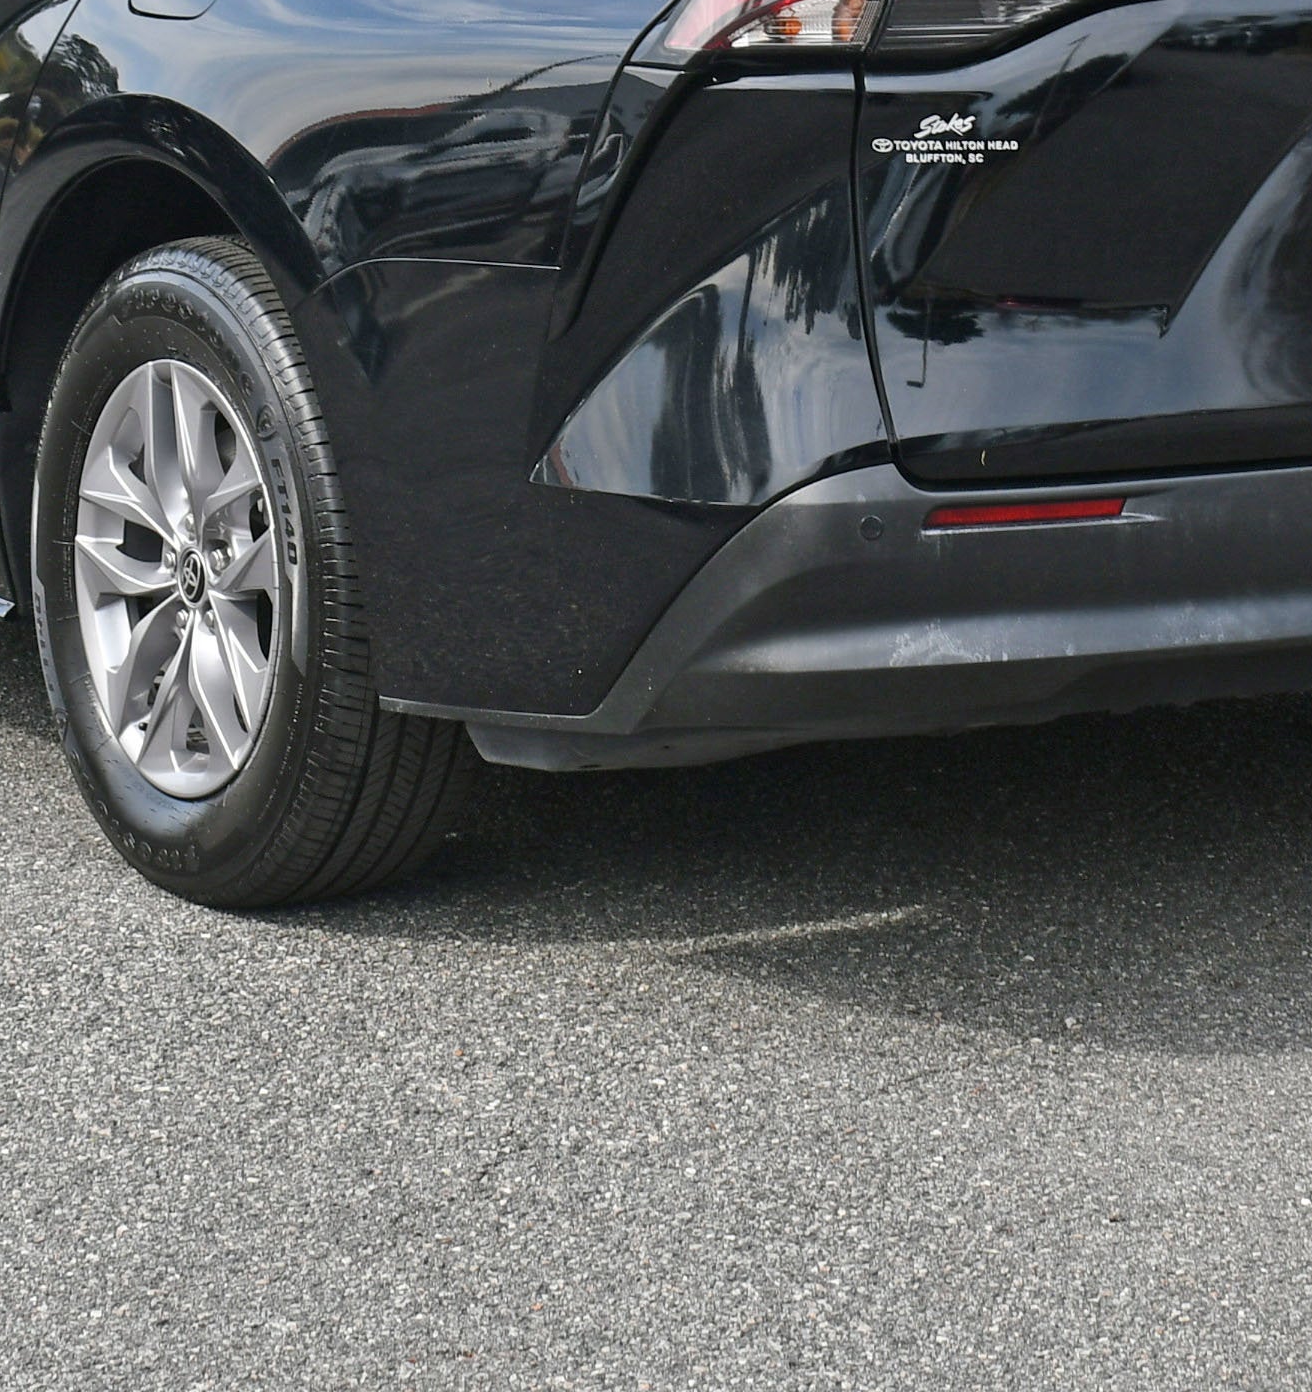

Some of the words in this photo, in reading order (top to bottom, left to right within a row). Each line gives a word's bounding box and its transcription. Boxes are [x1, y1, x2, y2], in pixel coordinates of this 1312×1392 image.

[914, 113, 976, 138] Stokes
[893, 140, 944, 151] TOYOTA
[945, 140, 985, 151] HILTON
[987, 140, 1019, 151] HEAD
[905, 153, 966, 165] BLUFFTON,
[968, 153, 984, 164] SC
